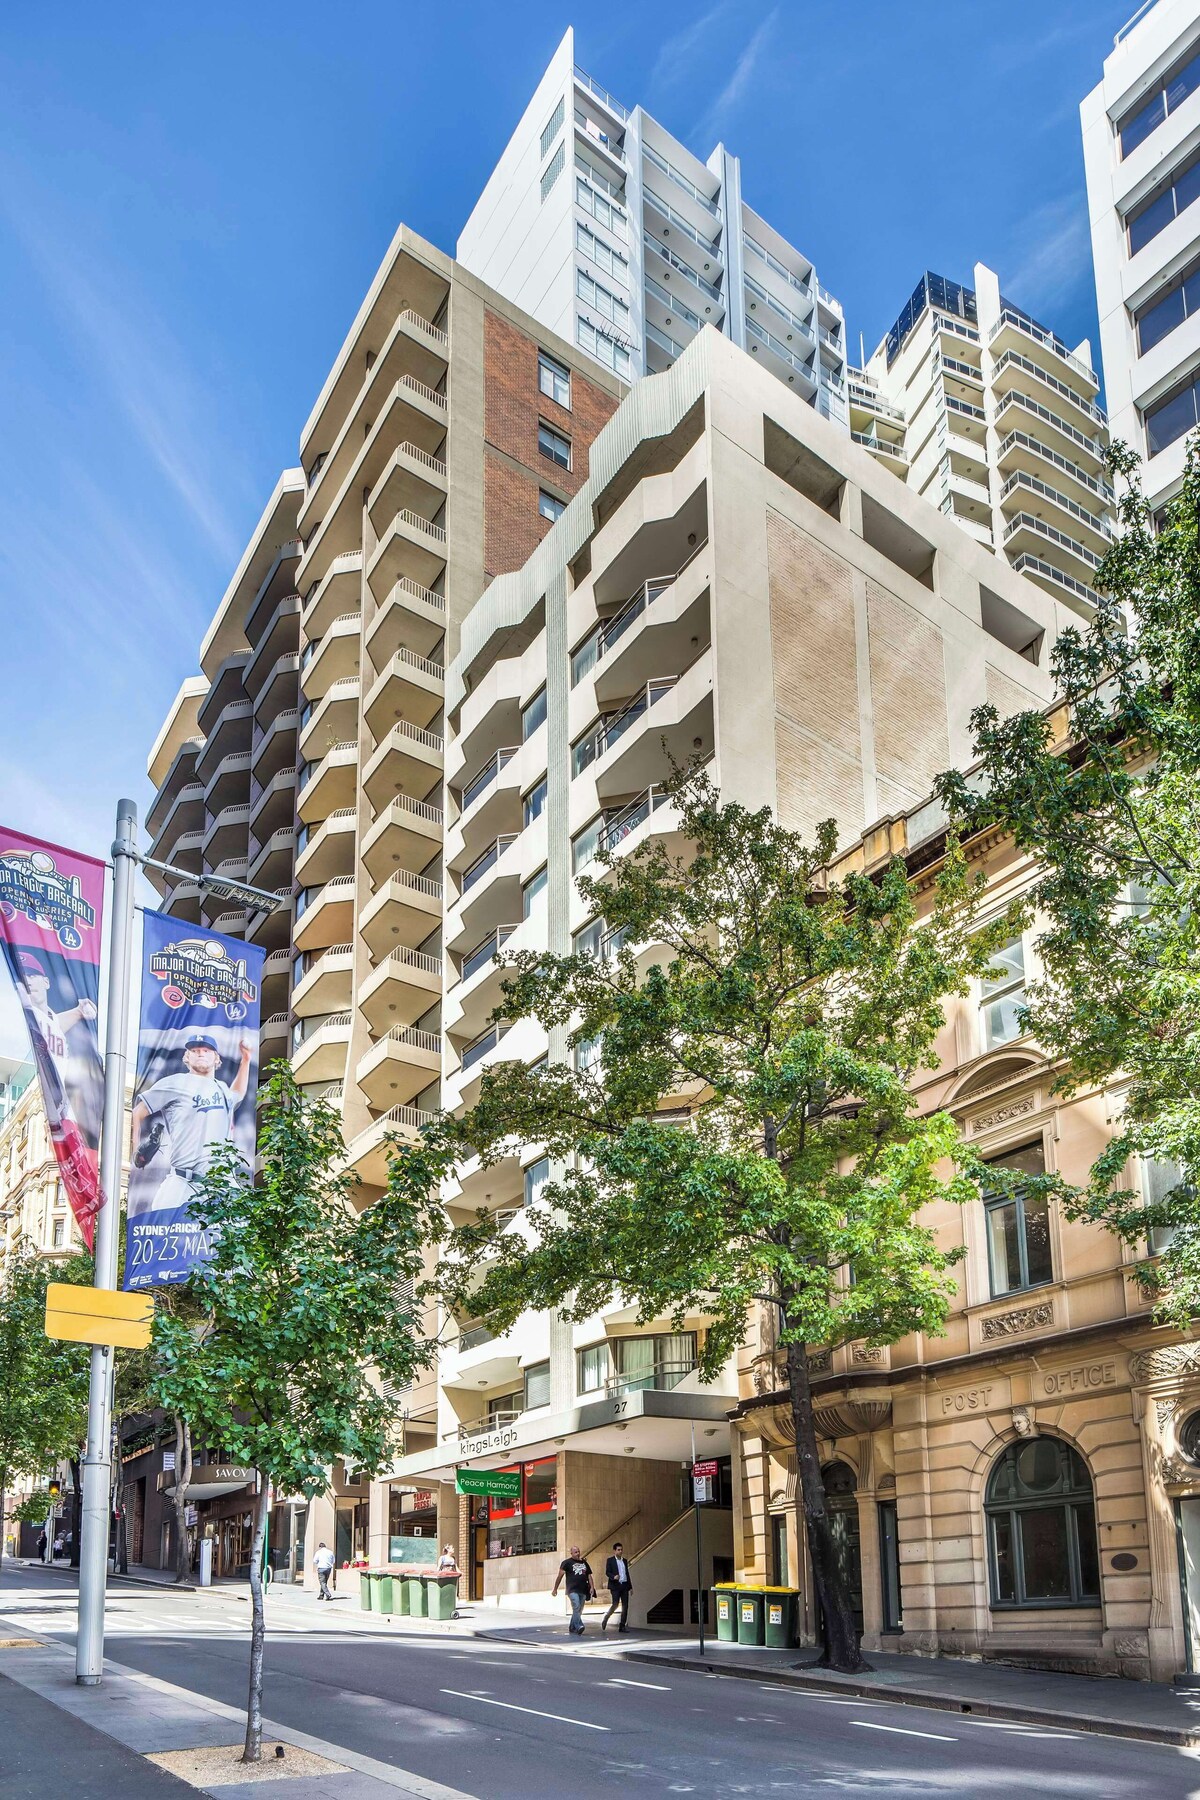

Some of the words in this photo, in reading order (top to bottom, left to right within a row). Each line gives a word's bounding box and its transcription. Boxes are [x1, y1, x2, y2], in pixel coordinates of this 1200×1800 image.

[13, 871, 45, 893] LEAGUE
[47, 885, 92, 924] BASEBALL
[153, 957, 184, 971] MAJOR
[186, 961, 216, 980] LEAGUE
[217, 970, 255, 999] BASEBALL
[173, 973, 208, 988] OPENING
[209, 984, 237, 997] SERIES
[132, 1225, 171, 1237] SYDNEY
[169, 1222, 203, 1234] CRICK
[131, 1235, 180, 1267] 20-23
[941, 1386, 993, 1415] POST
[1044, 1361, 1117, 1394] OFFICE
[613, 1401, 628, 1415] 27
[215, 1468, 249, 1478] SAVOY
[460, 1478, 485, 1488] Peace
[486, 1480, 519, 1491] Harmony
